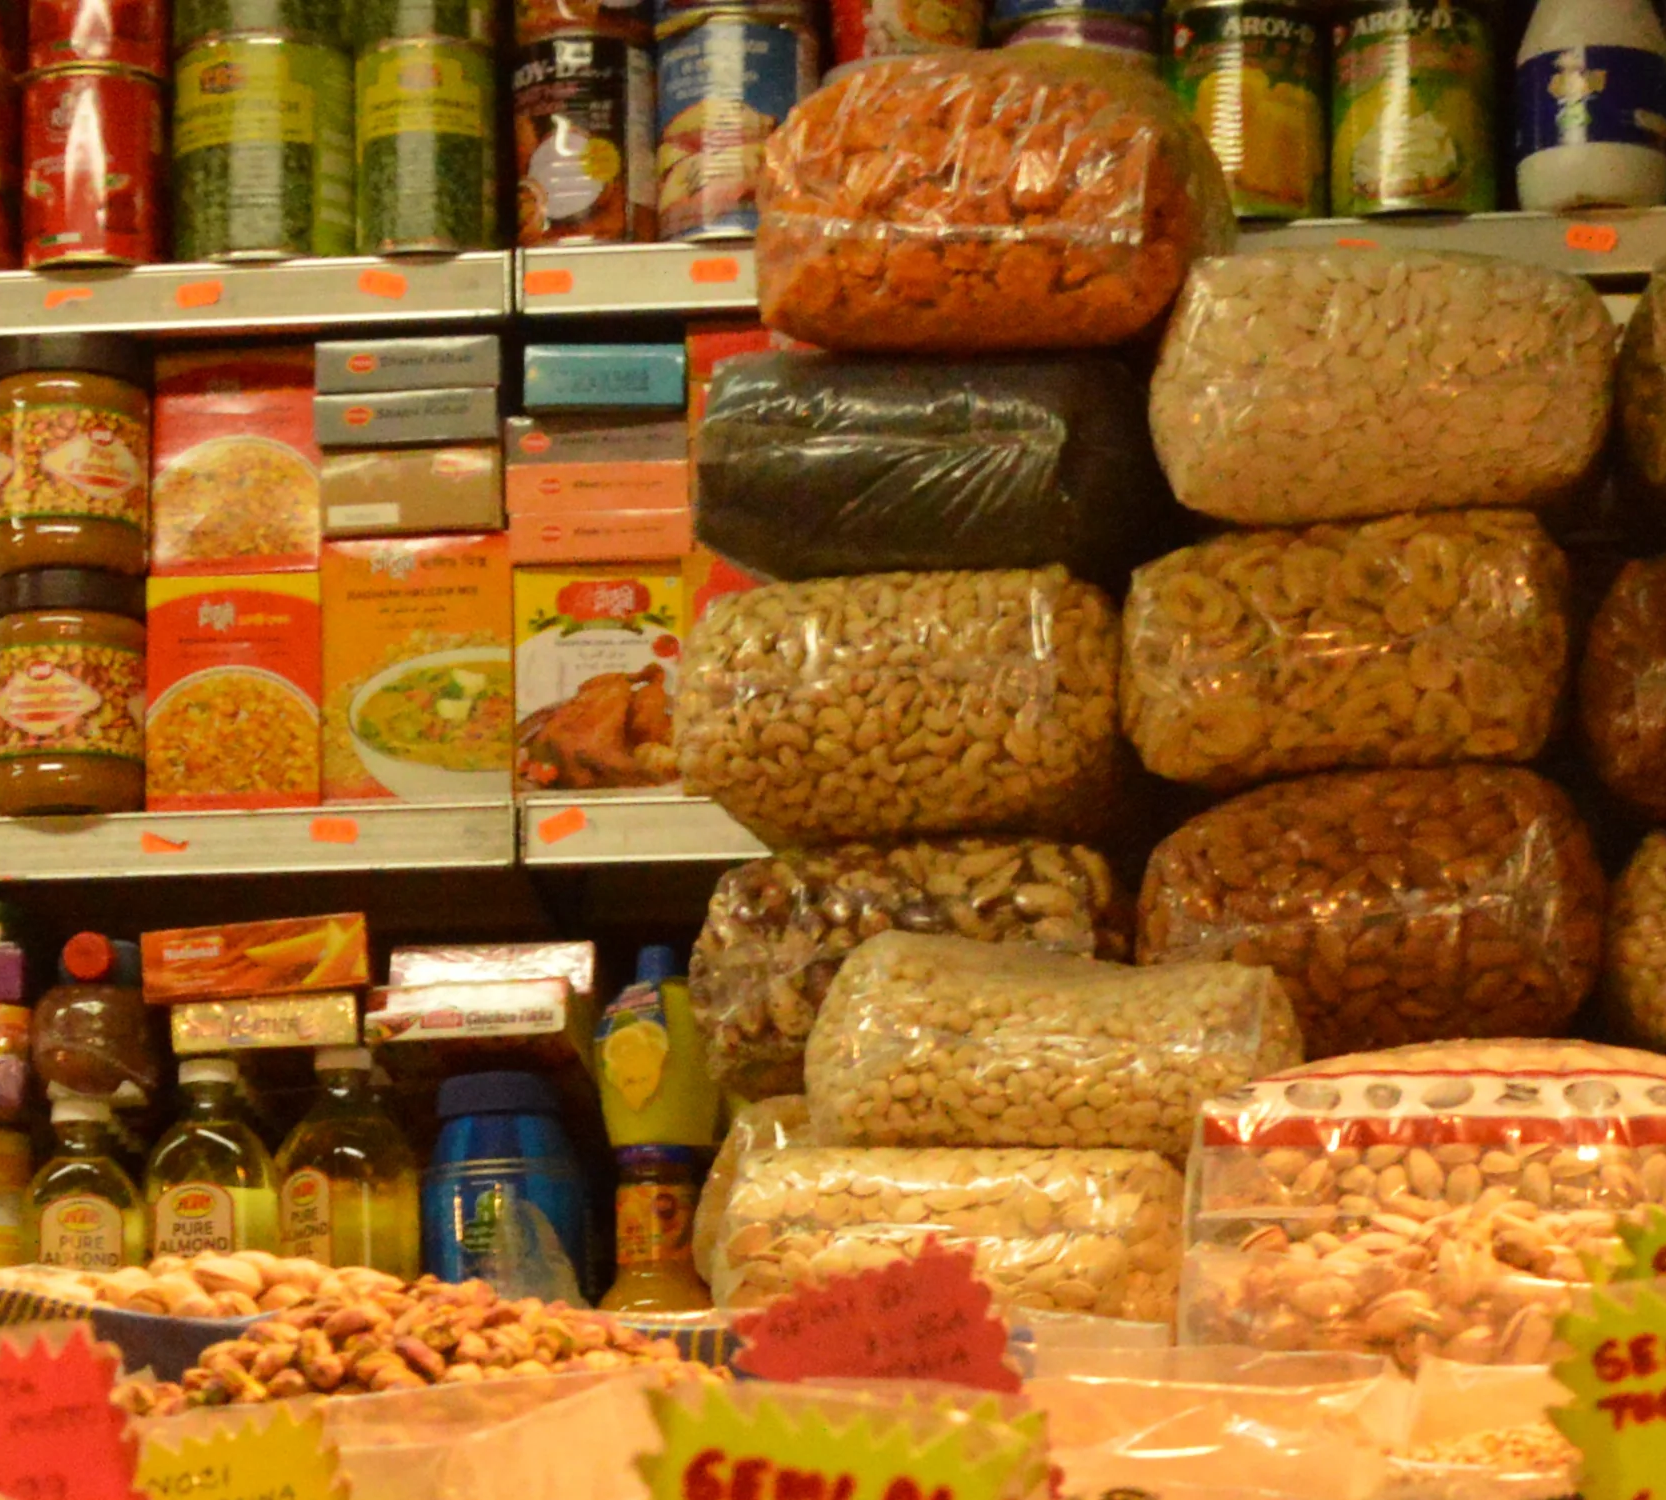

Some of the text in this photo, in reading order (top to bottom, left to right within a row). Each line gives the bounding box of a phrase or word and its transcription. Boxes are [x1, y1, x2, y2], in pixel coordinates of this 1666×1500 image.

[172, 1221, 214, 1237] PURE
[58, 1235, 105, 1250] PURE
[157, 1236, 229, 1253] ALMOND
[44, 1252, 119, 1268] ALMOND
[147, 1464, 230, 1497] NOCI
